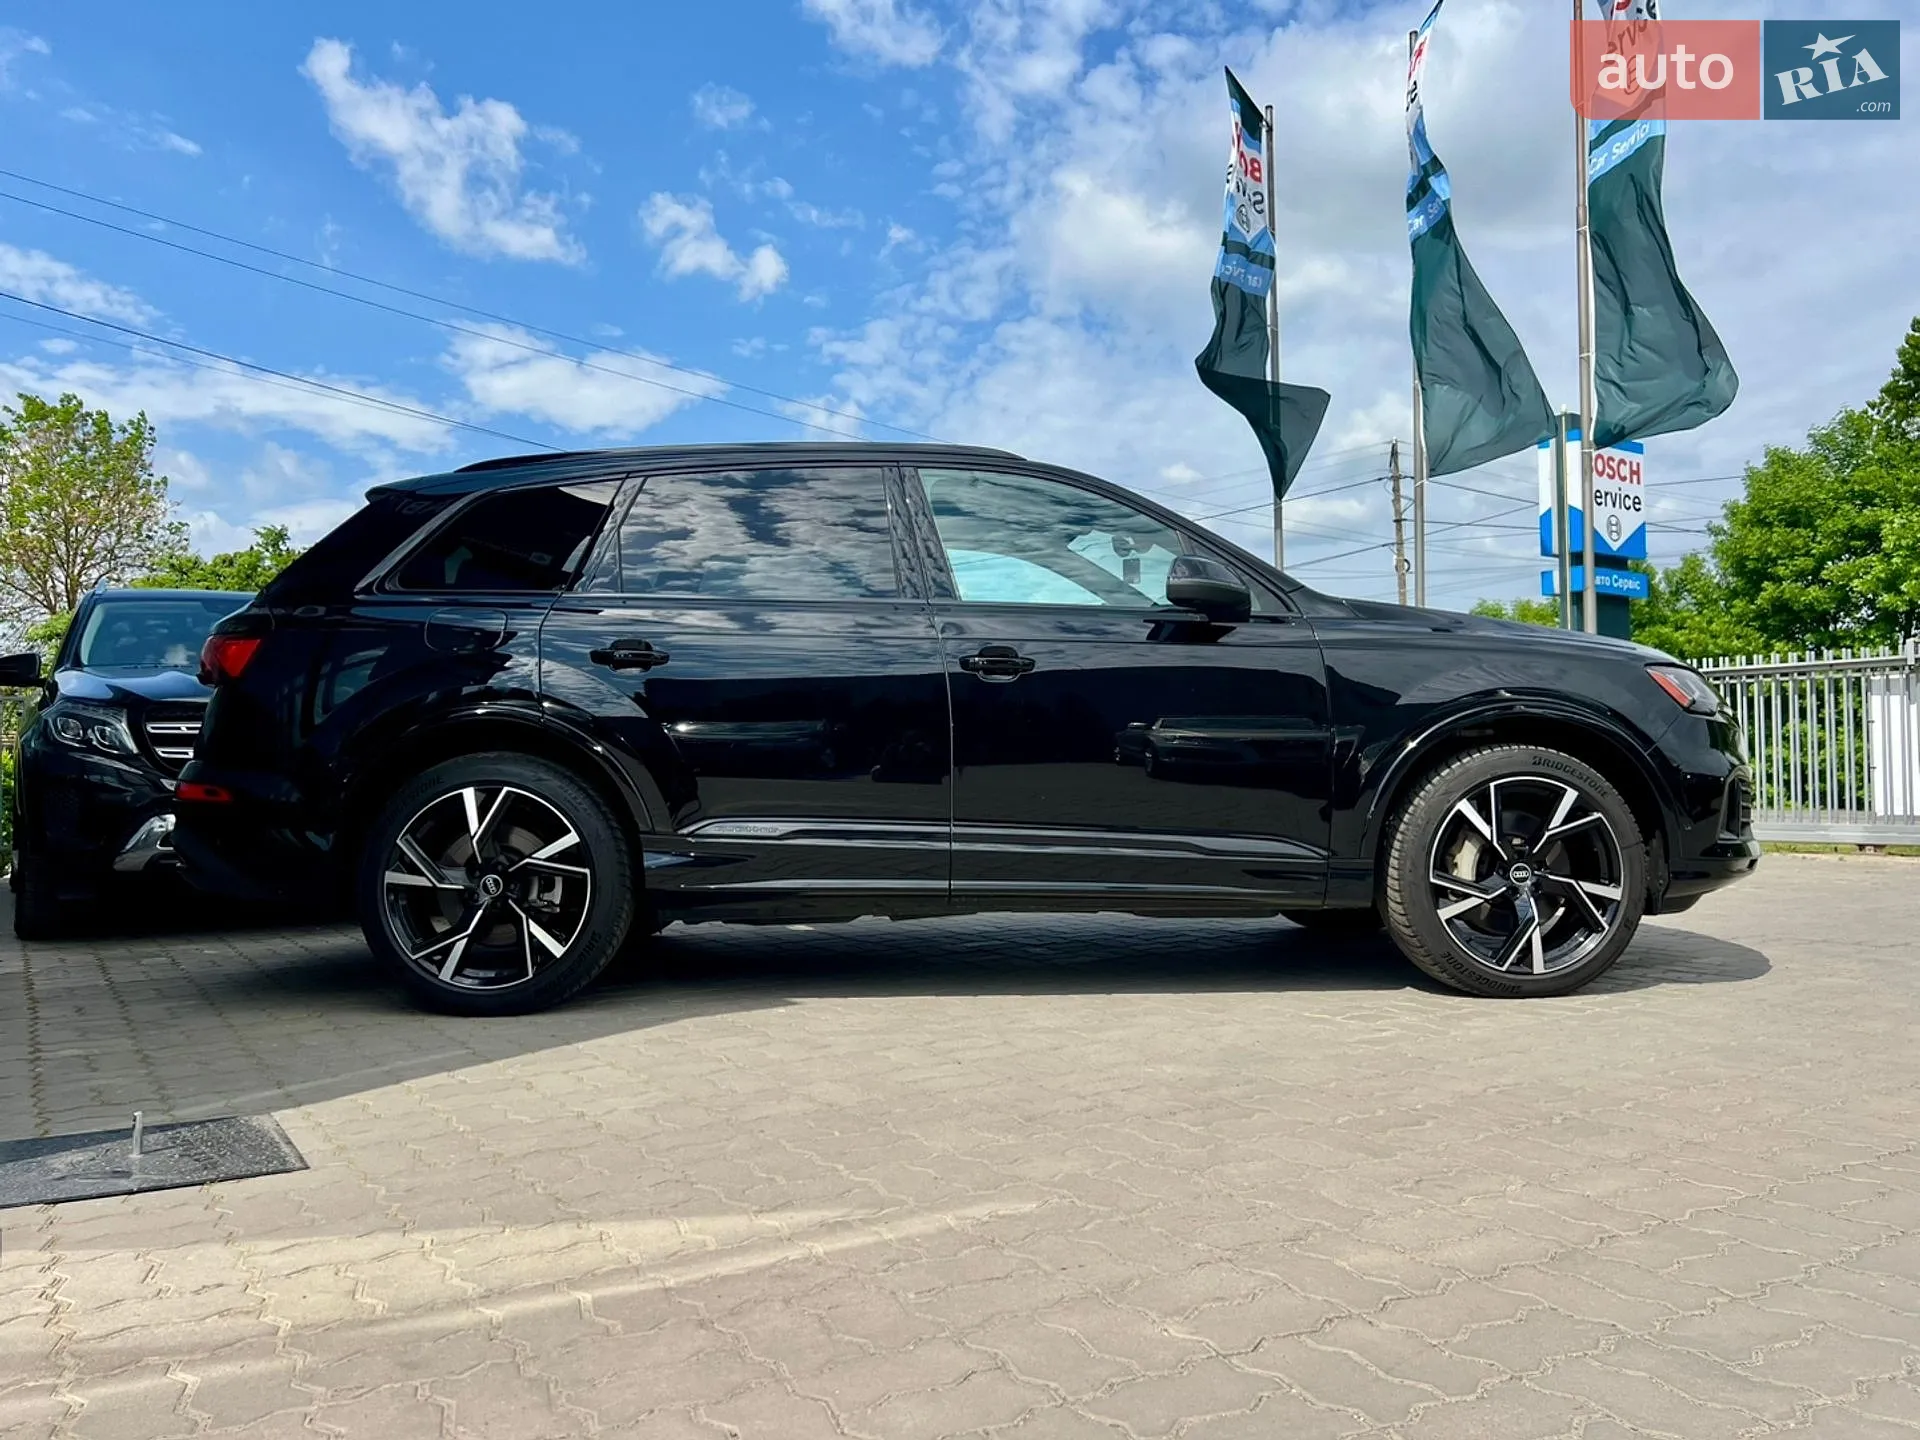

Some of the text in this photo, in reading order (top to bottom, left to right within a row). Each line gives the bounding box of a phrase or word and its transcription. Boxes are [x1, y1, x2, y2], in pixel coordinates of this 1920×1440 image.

[1592, 453, 1641, 485] OSCH
[1593, 489, 1642, 512] ervice
[1531, 755, 1611, 800] BRIDGESTONE
